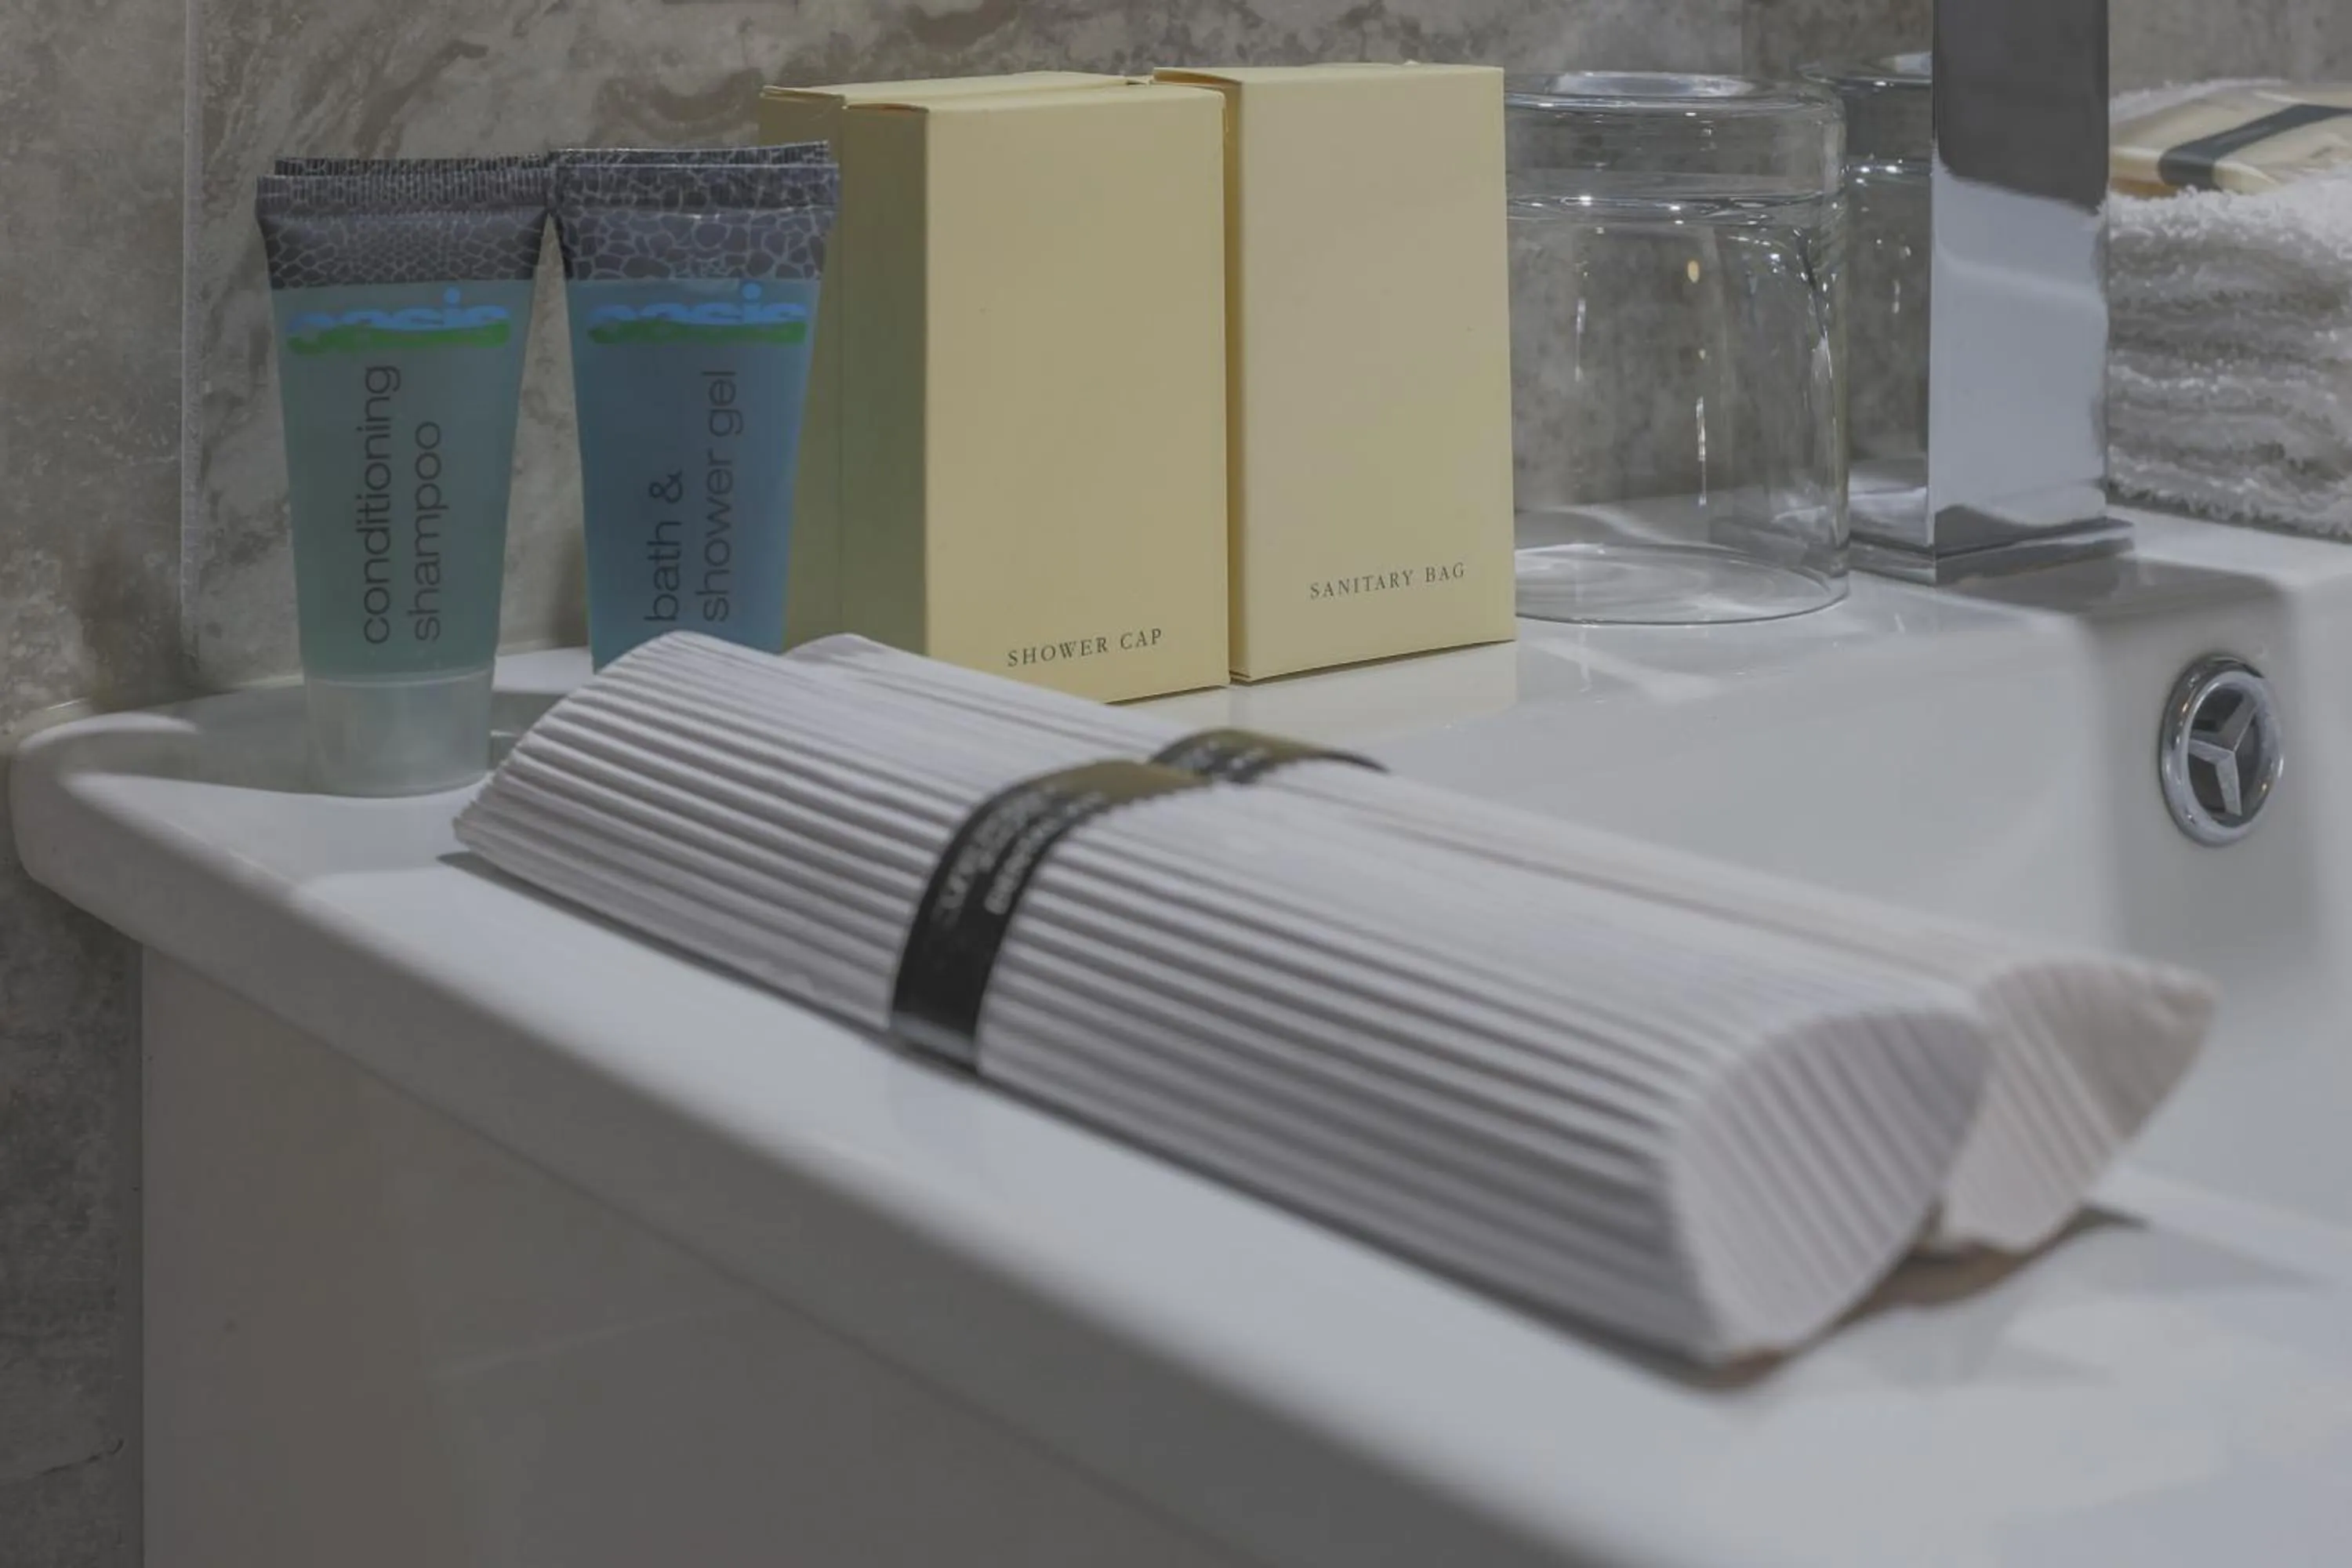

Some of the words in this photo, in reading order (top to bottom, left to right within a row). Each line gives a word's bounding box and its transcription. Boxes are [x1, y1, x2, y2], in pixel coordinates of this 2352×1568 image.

[702, 369, 743, 438] gel
[356, 364, 401, 645] conditioning
[650, 465, 684, 504] &
[407, 420, 449, 642] shampoo
[644, 518, 682, 622] bath
[695, 448, 735, 622] shower
[1309, 570, 1414, 600] SANITARY
[1425, 562, 1465, 583] BAG
[1007, 637, 1109, 667] SHOWER
[1120, 628, 1163, 651] CAP
